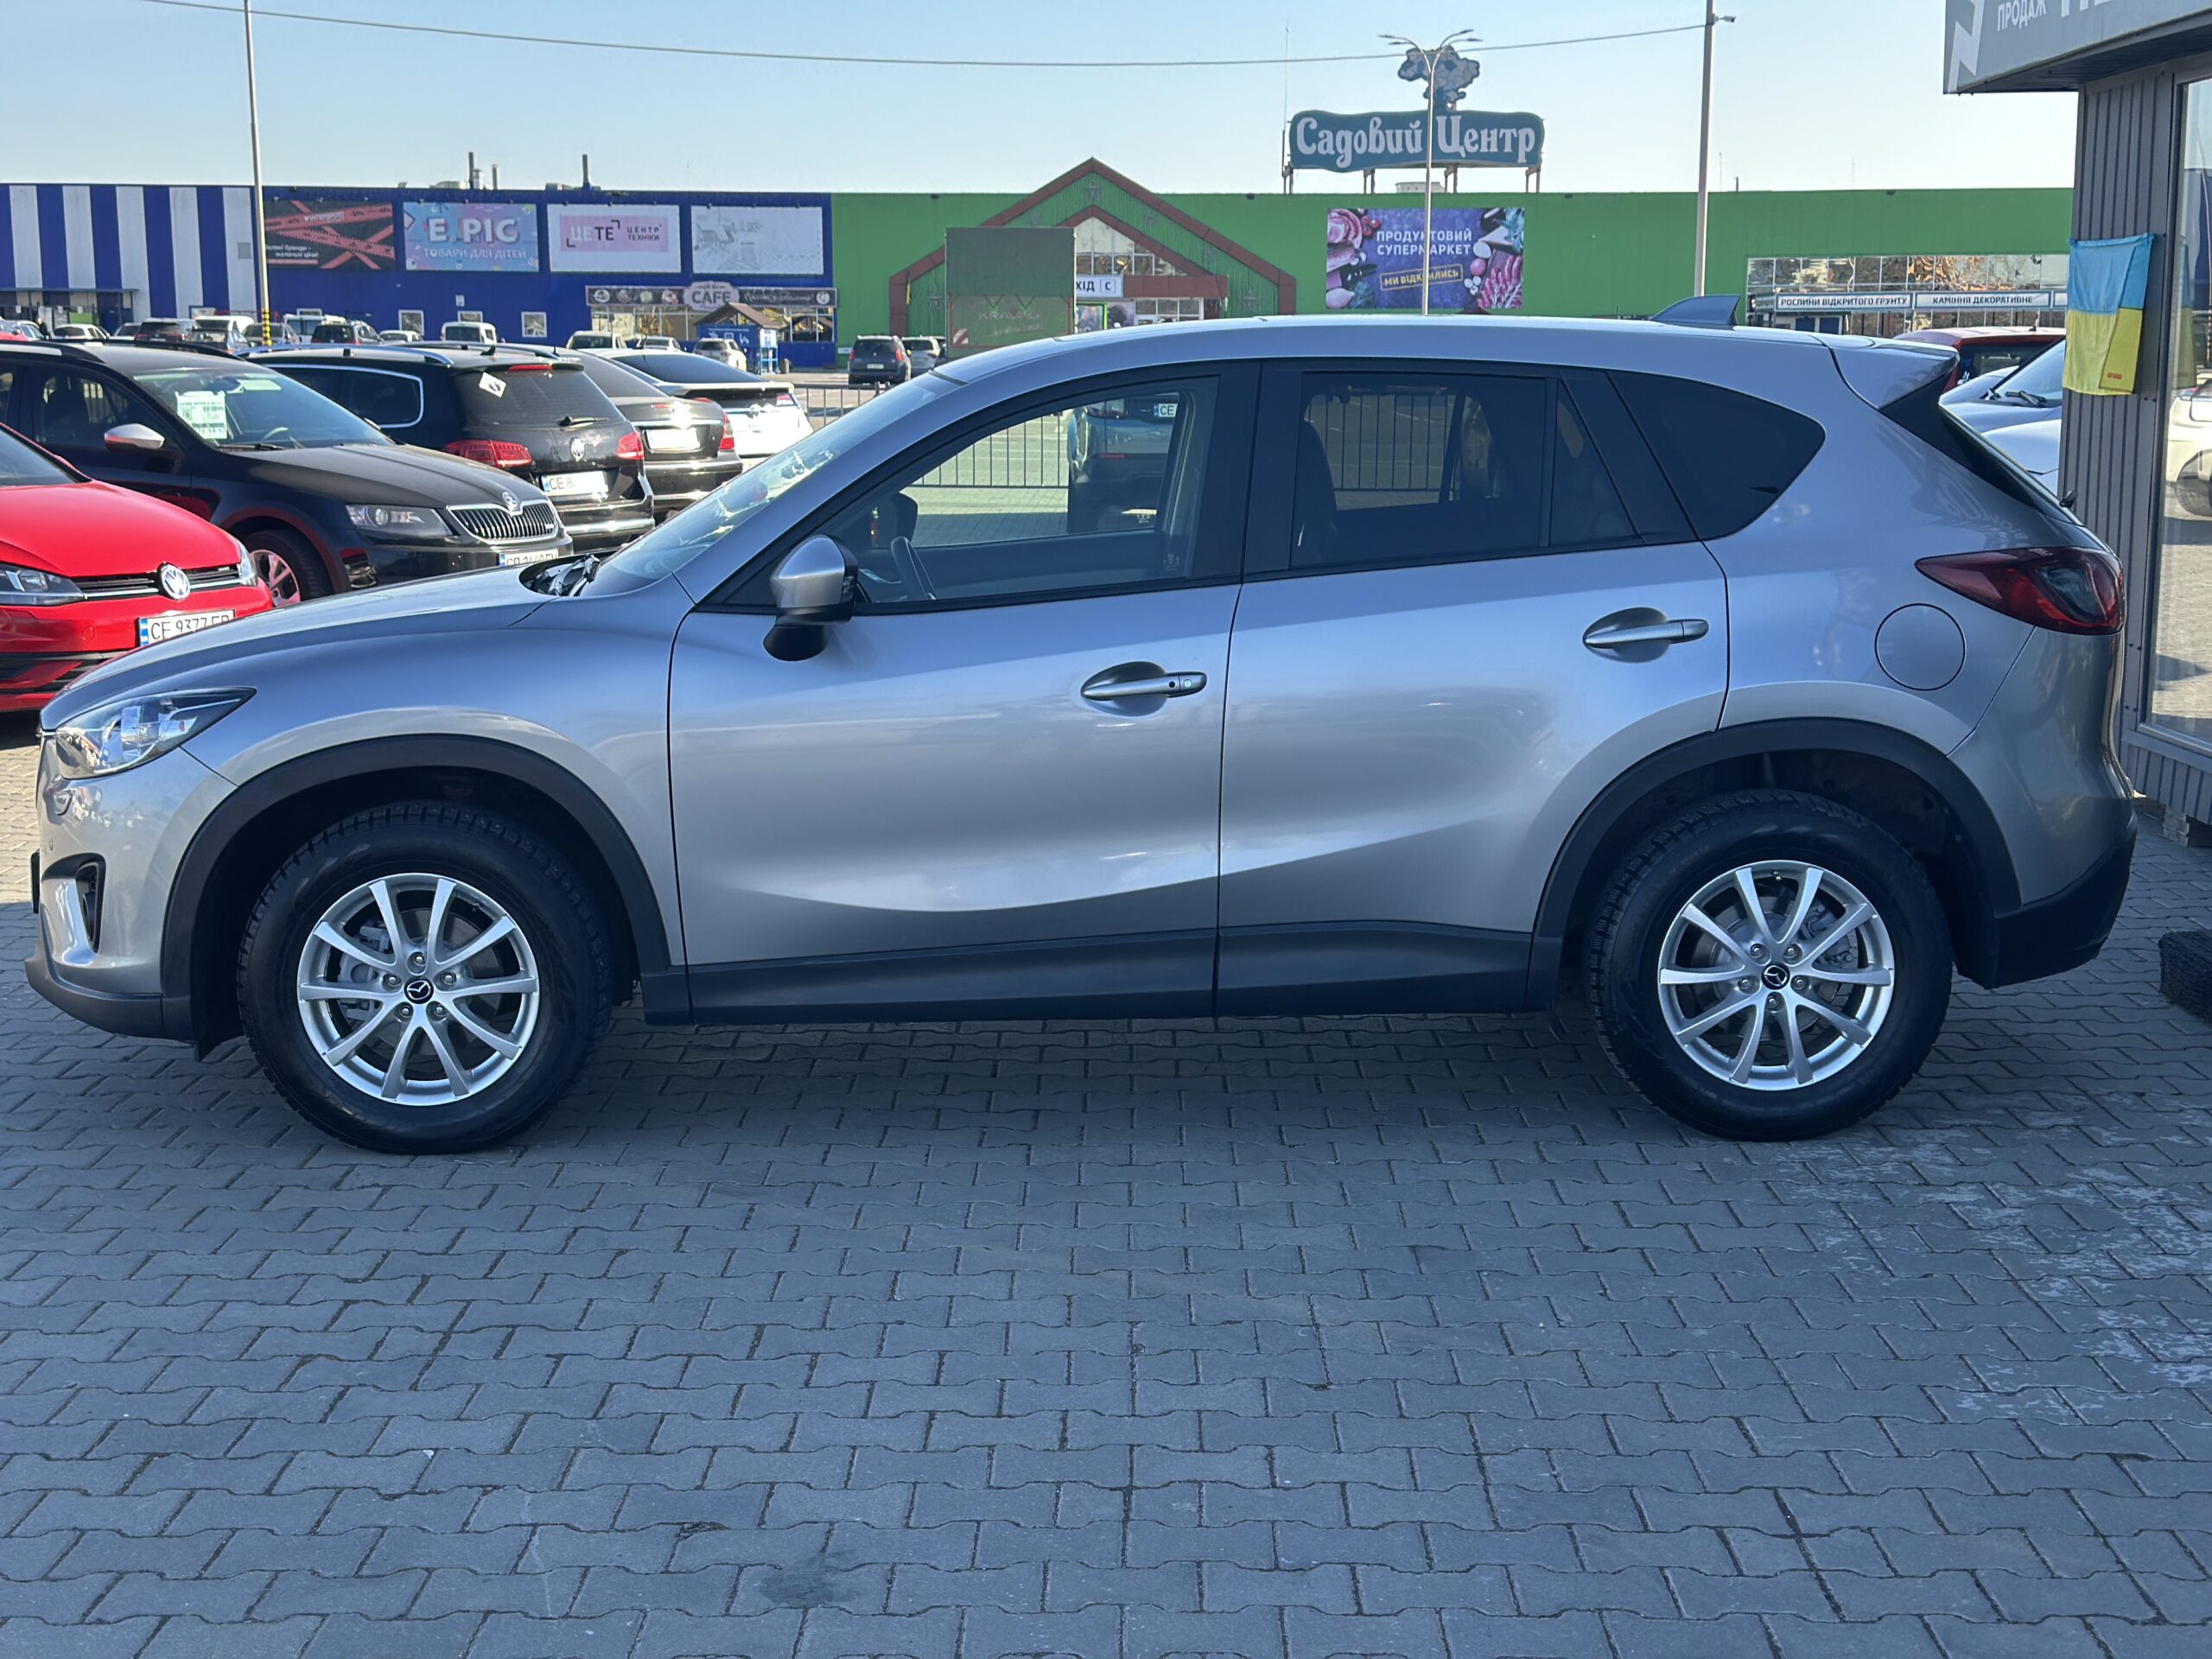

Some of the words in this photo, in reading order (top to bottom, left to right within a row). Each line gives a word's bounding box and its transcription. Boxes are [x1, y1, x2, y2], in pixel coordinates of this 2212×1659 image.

[1997, 0, 2047, 31] ПРОДАЖ
[1296, 117, 1423, 168] Садовий
[1436, 115, 1535, 163] Центр
[626, 226, 660, 234] ЦЕНТР
[424, 248, 467, 258] ТОВАРИ
[470, 249, 493, 260] ДЛЯ
[494, 247, 526, 260] ДІТЕЙ
[1384, 277, 1399, 286] МИ
[1401, 270, 1459, 284] ВІДКИЛИСЬ
[1076, 281, 1095, 292] ХІД
[691, 290, 732, 303] CAFE
[1781, 297, 1821, 307] РОСЛИНИ
[1821, 297, 1874, 306] ВІДКРИТОГО
[1933, 296, 1971, 305] КАМІННЯ
[1973, 296, 2033, 304] ДЕКОРАТИВНЕ
[1160, 404, 1174, 416] CE
